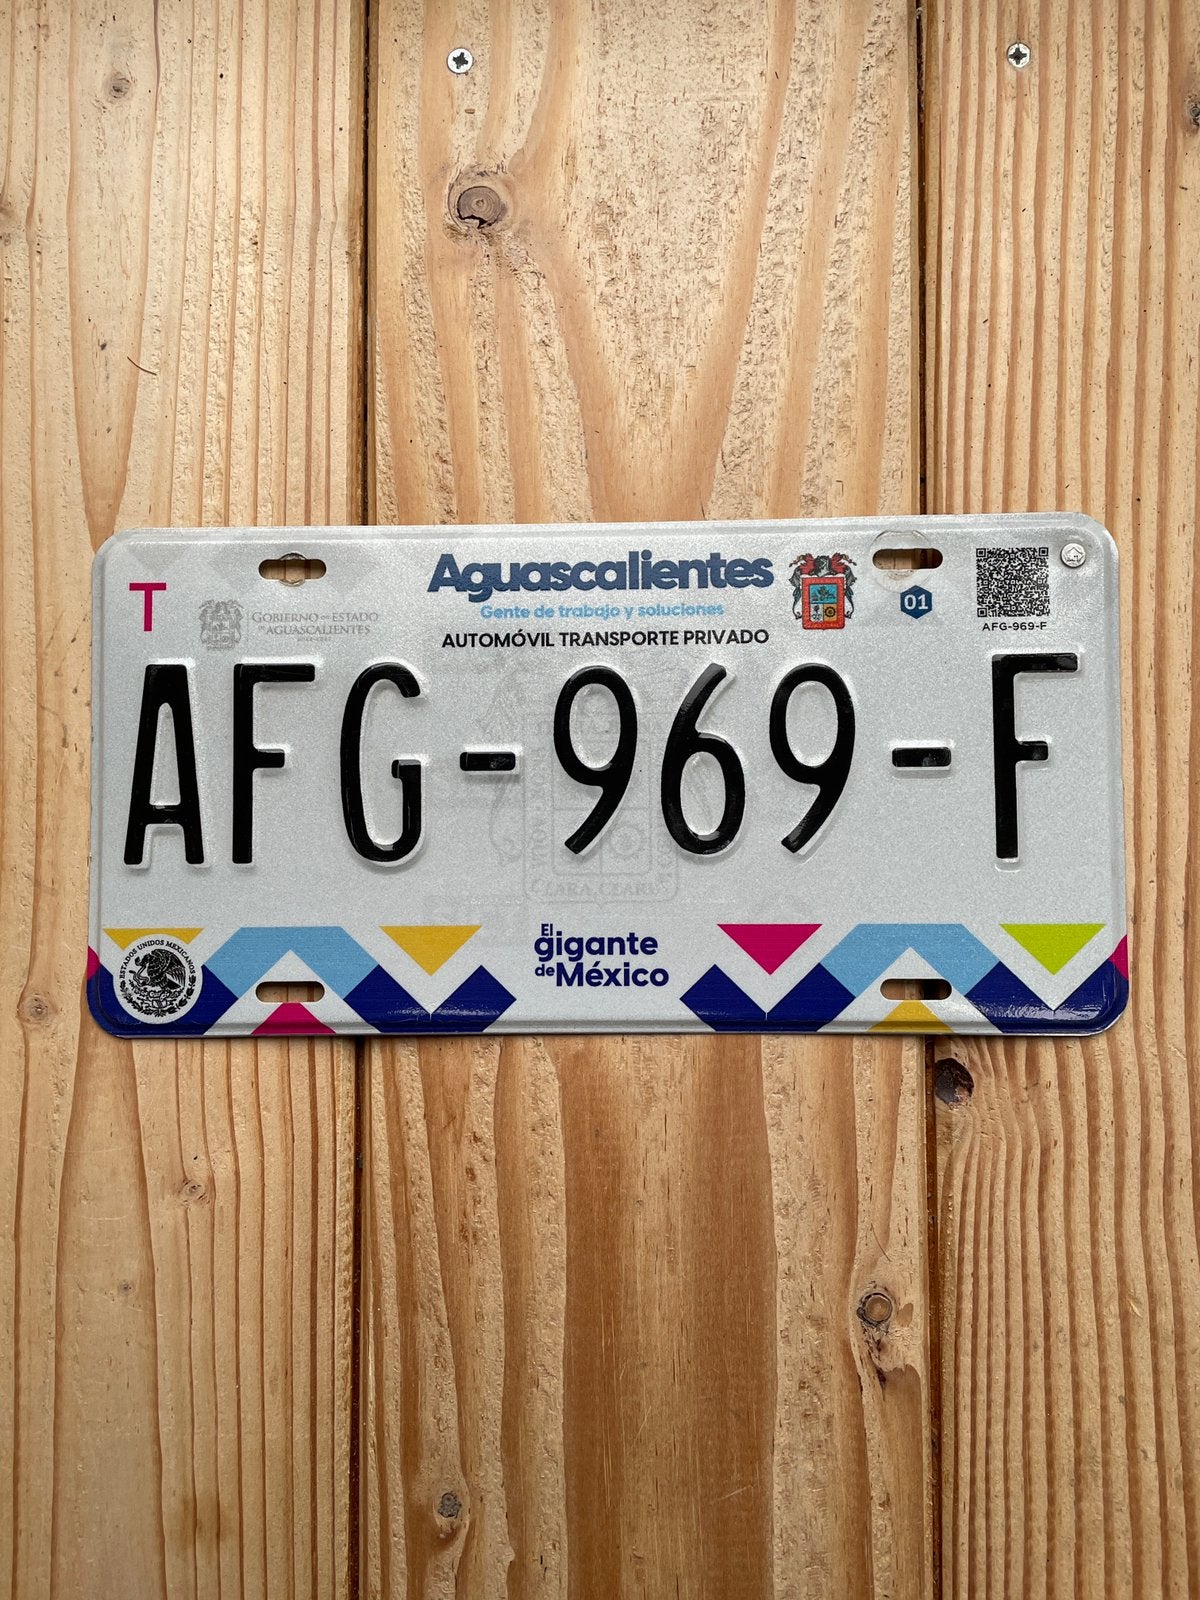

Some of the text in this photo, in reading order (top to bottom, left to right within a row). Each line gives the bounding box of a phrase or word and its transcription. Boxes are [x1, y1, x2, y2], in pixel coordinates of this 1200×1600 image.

[427, 550, 774, 602] Aguascalientes
[128, 582, 167, 632] T
[480, 602, 725, 620] Gente de trabajo y soluciones
[903, 594, 929, 611] 01
[251, 611, 318, 622] GOBIERNO
[332, 612, 379, 622] ESTADO
[982, 621, 1048, 632] AFG-969-F
[265, 624, 371, 635] AGUASCALIENTES
[441, 627, 770, 648] AUTOMÓVIL TRANSPORTE PRIVADO
[124, 653, 1077, 867] AFG-969-F
[541, 923, 553, 936] El
[534, 931, 658, 962] gigante
[119, 940, 196, 979] ESTADOS UNIDOS MEXICANOS
[535, 961, 669, 987] de México
